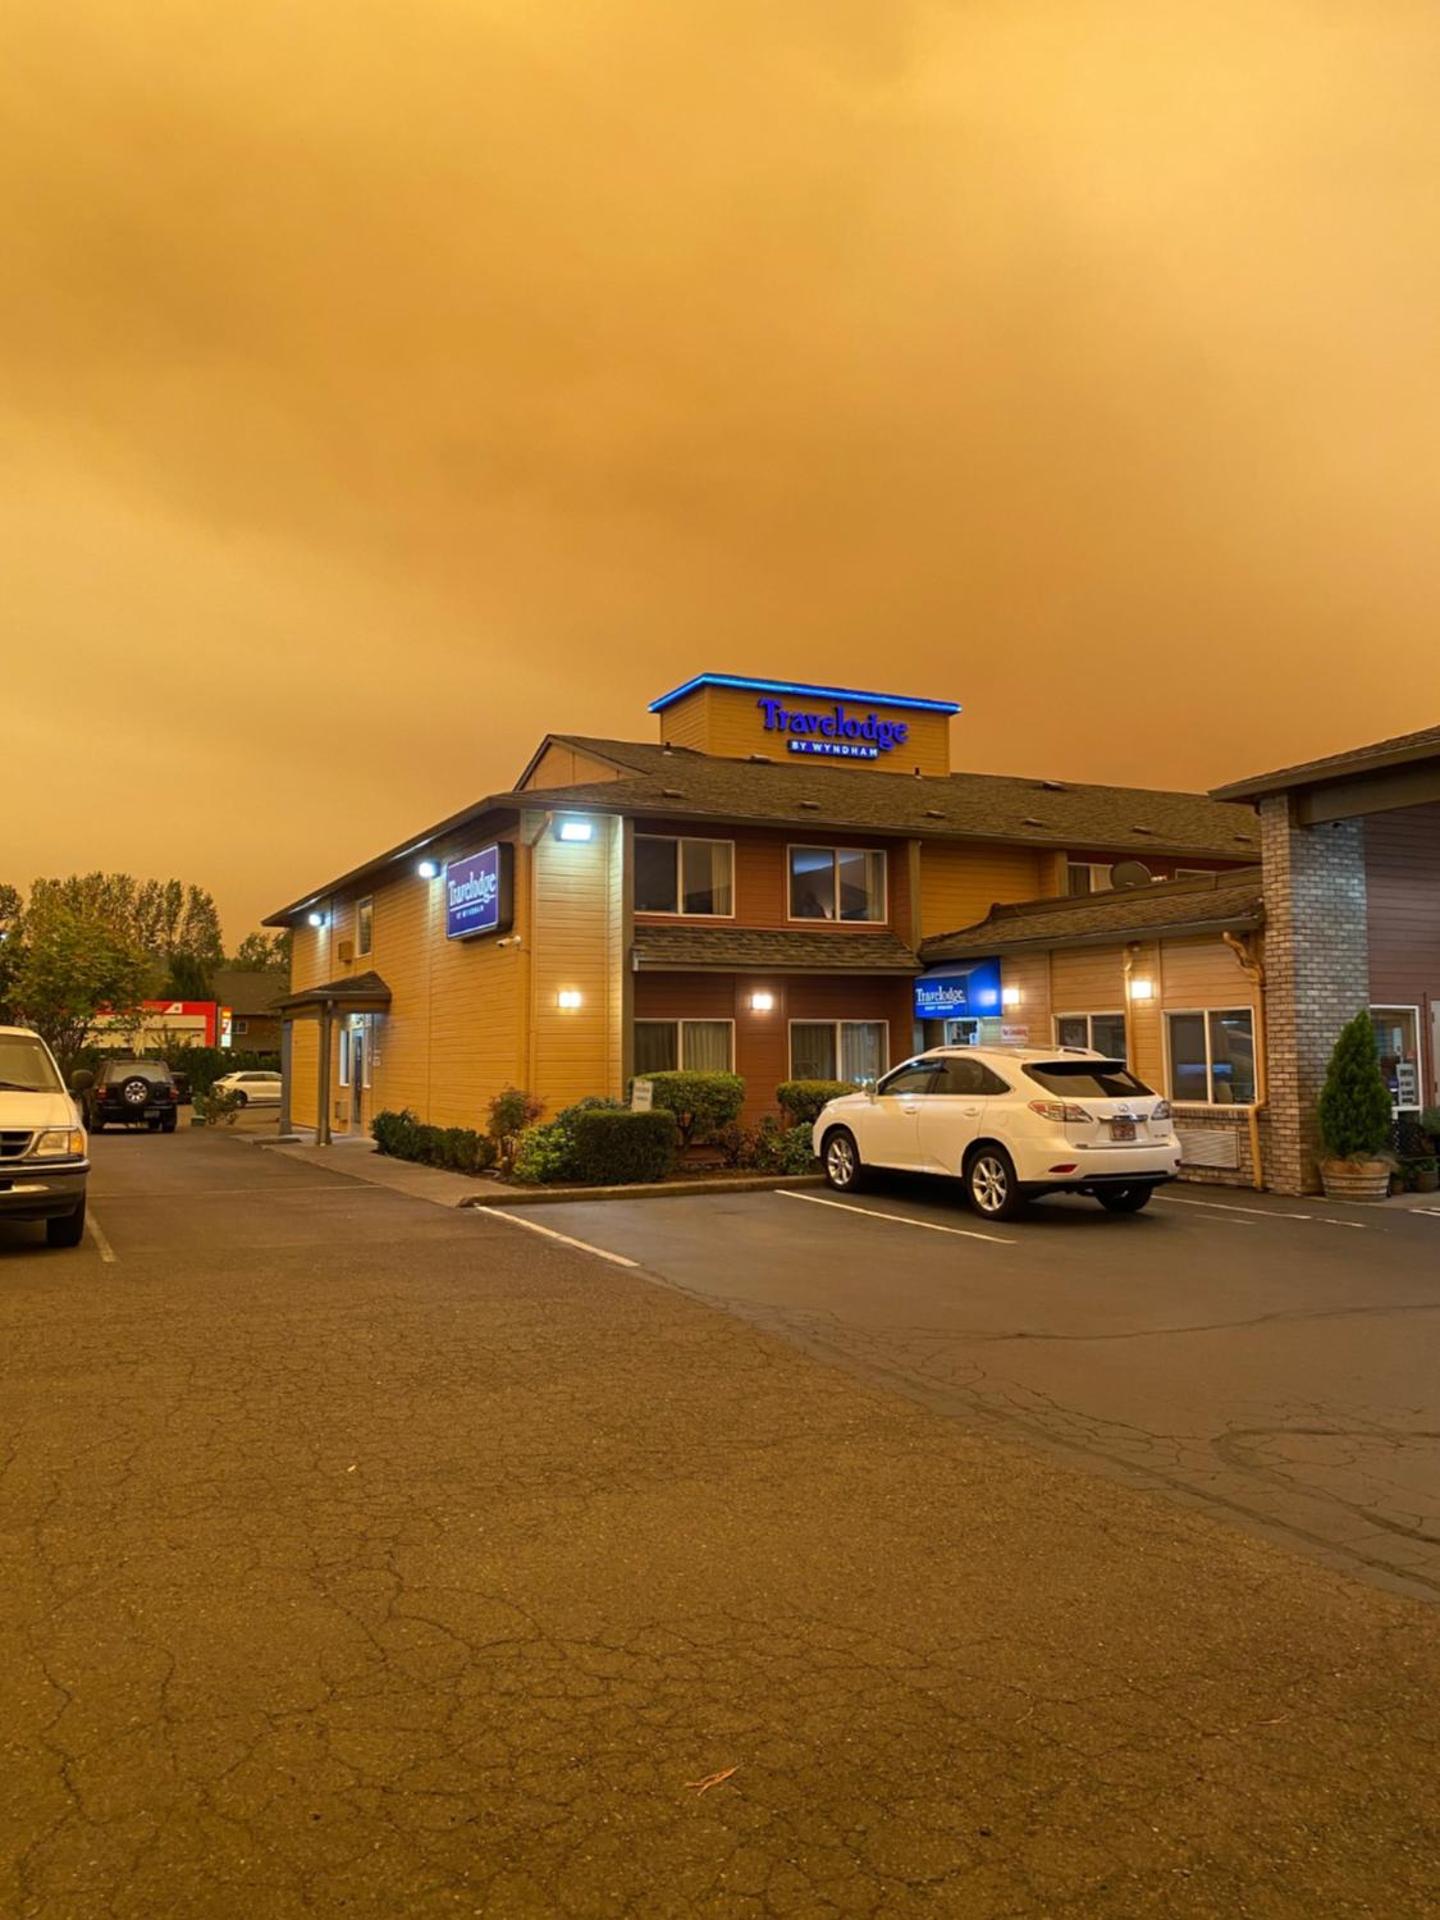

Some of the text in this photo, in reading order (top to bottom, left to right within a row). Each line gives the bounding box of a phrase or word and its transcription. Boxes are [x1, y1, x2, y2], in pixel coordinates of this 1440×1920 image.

[757, 697, 909, 751] Travelodge
[791, 741, 878, 757] BY WYNDHAM
